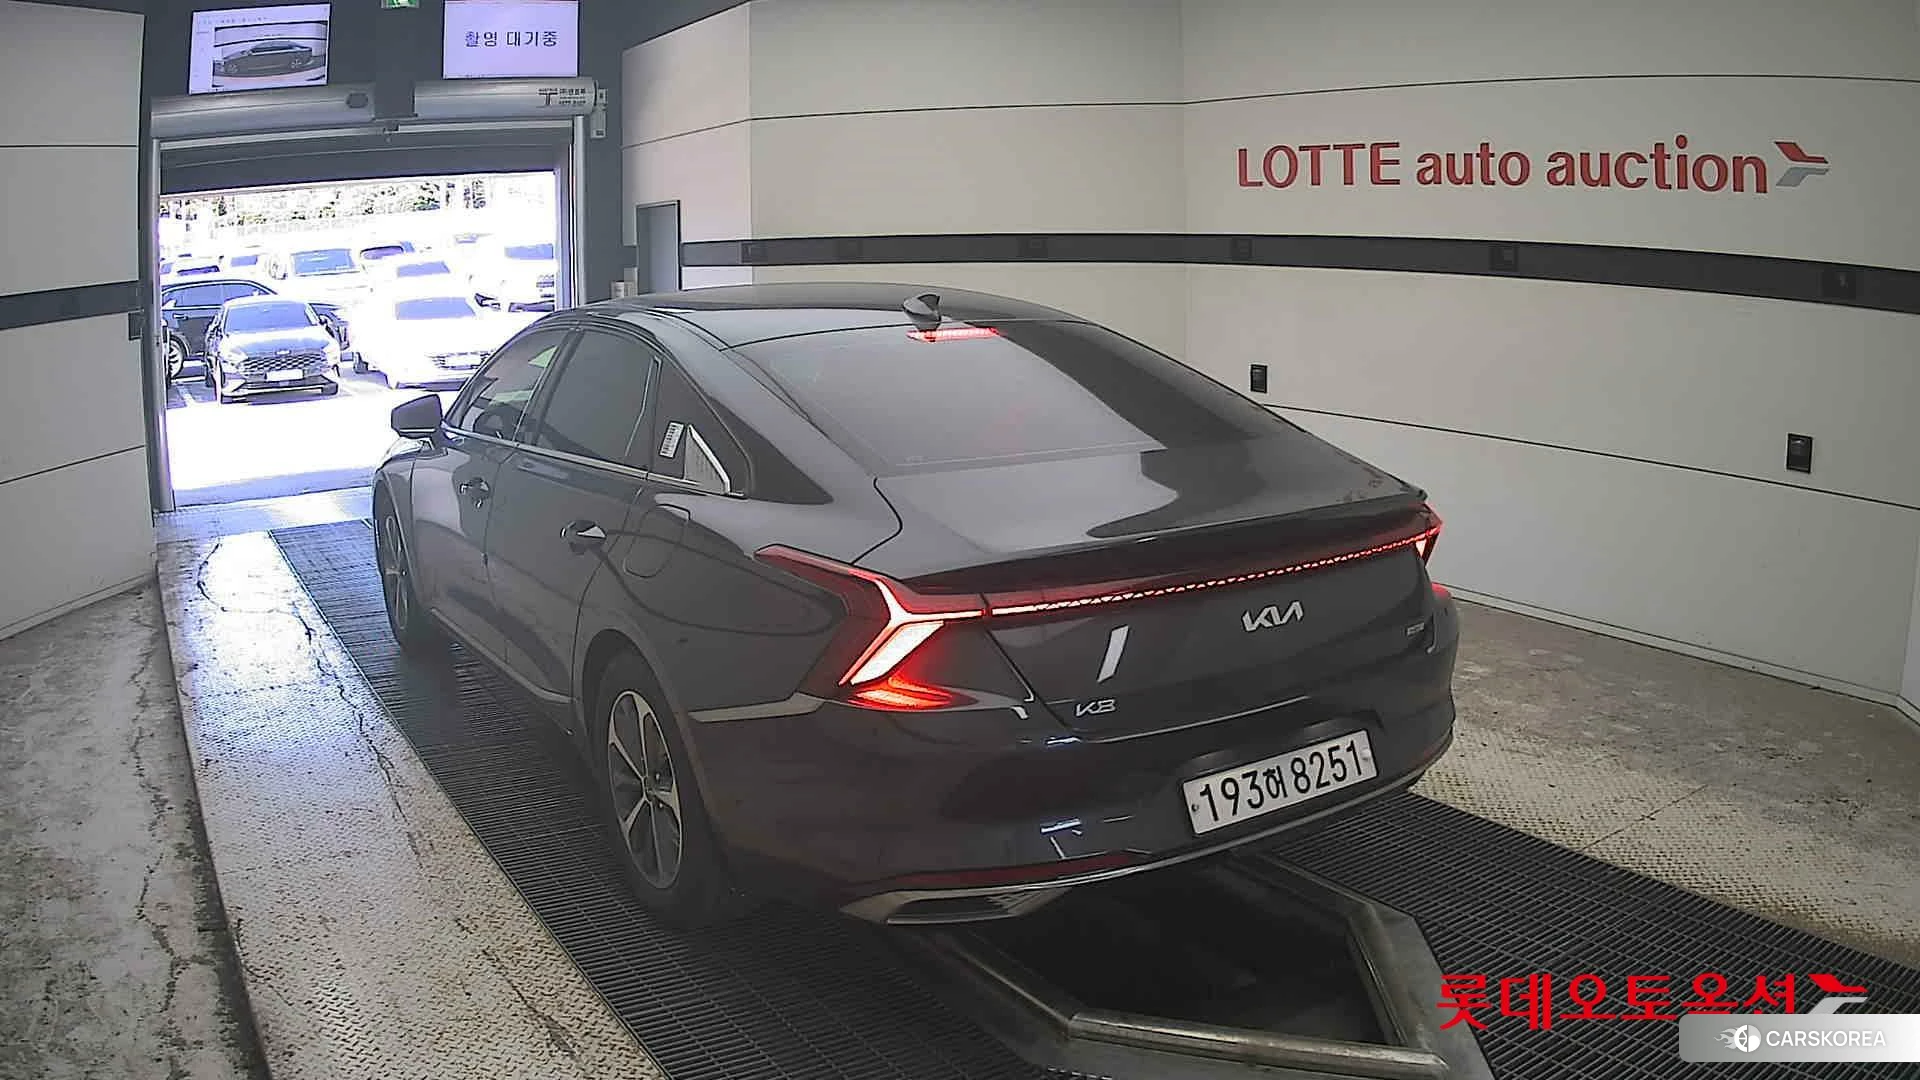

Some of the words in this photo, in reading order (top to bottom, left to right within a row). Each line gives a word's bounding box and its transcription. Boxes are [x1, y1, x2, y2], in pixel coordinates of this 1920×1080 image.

[506, 31, 558, 48] 대기중
[1237, 142, 1401, 189] LOTTE
[1416, 142, 1531, 187] auto
[1546, 135, 1768, 194] auction
[1075, 699, 1117, 717] K8
[1290, 740, 1362, 795] 8251
